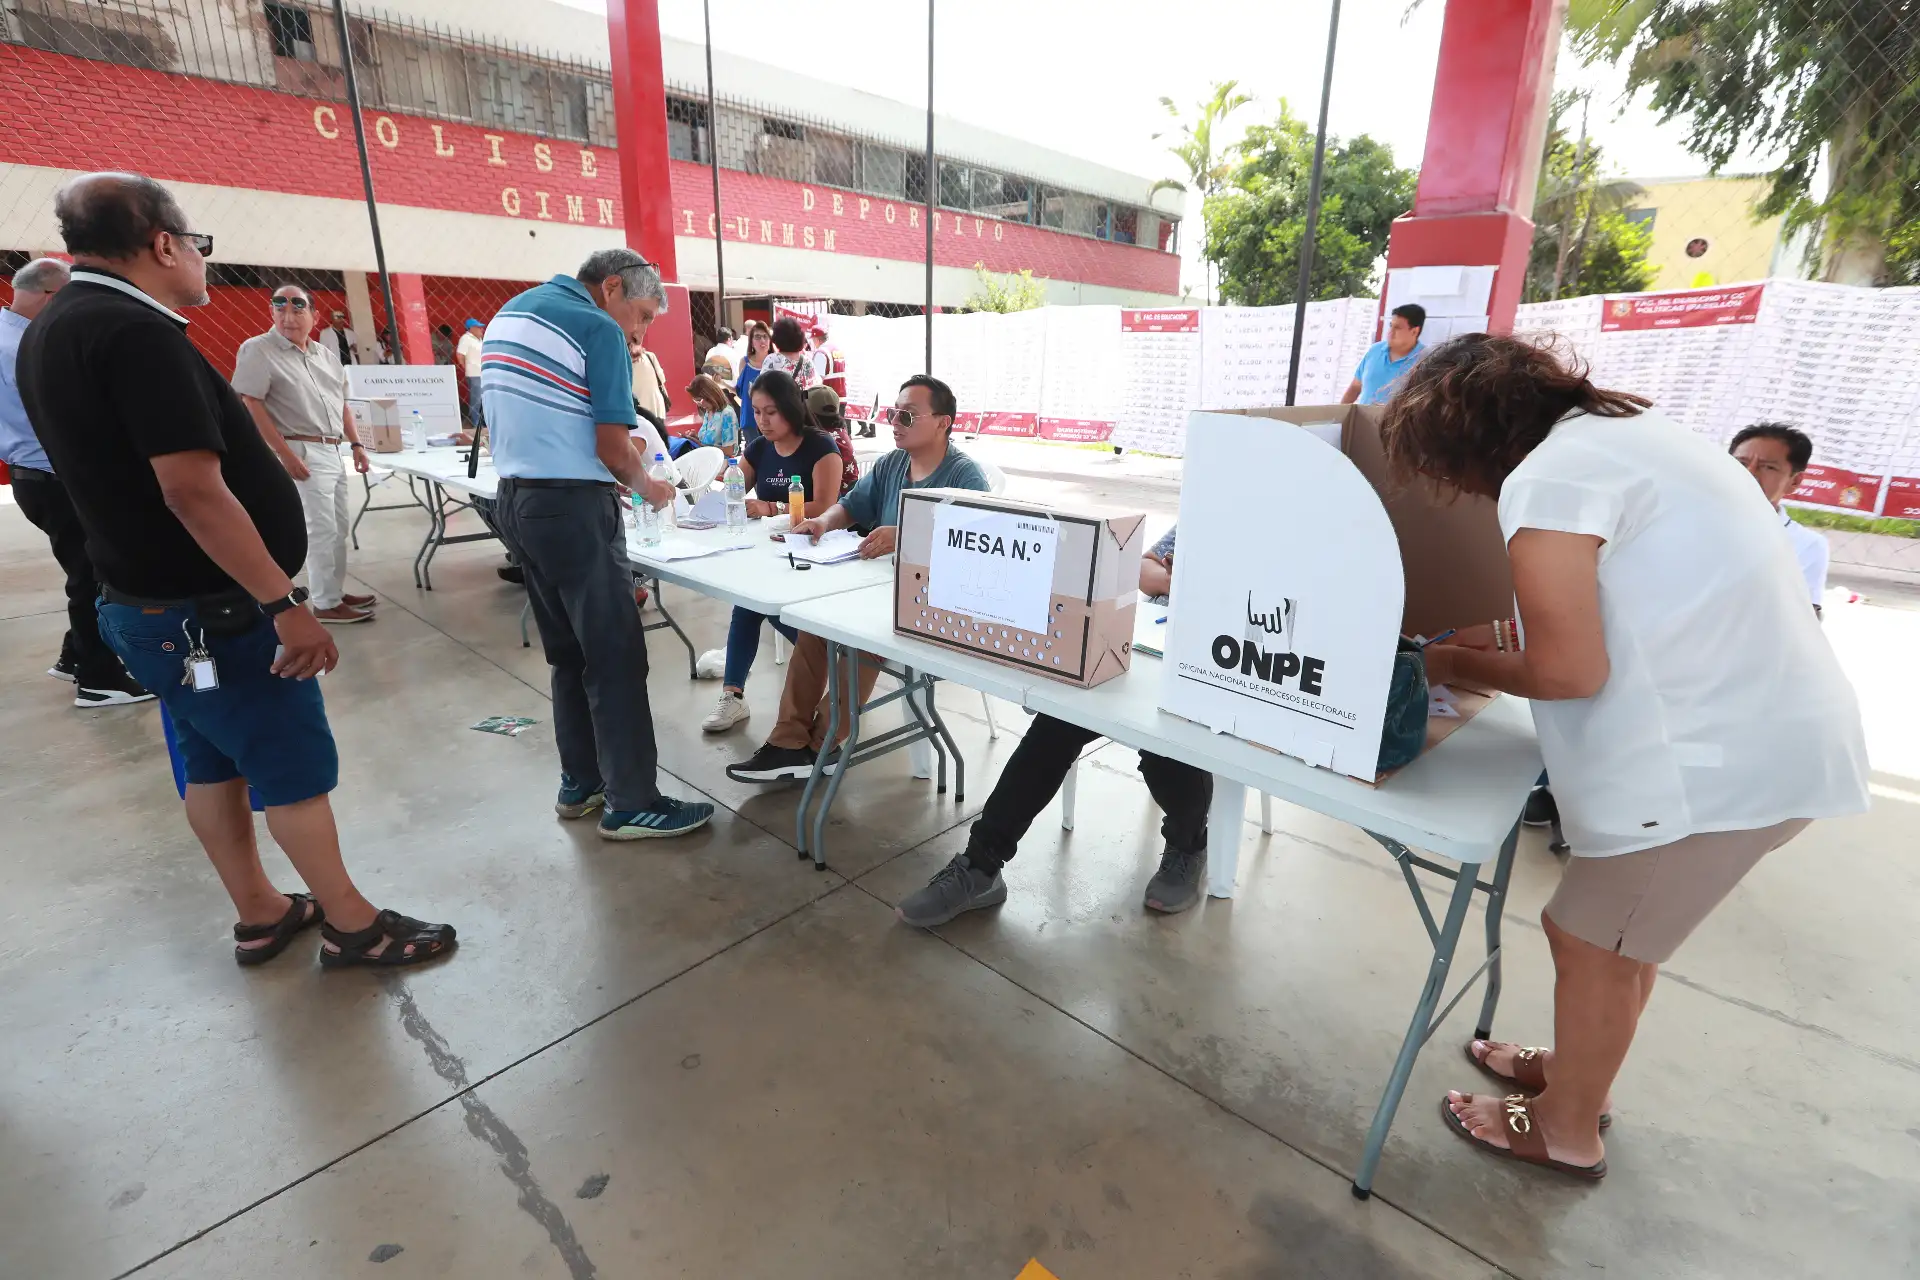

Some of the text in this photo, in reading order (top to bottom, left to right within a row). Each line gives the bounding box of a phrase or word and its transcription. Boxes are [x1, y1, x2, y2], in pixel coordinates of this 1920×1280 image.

[313, 106, 597, 178] COLISE
[803, 188, 1003, 242] DEPORTIVO
[948, 528, 1005, 556] MESA
[1179, 662, 1357, 721] OFICINA NACIONAL DE PROCESOS ELECTORALES
[1212, 634, 1325, 696] ONPE
